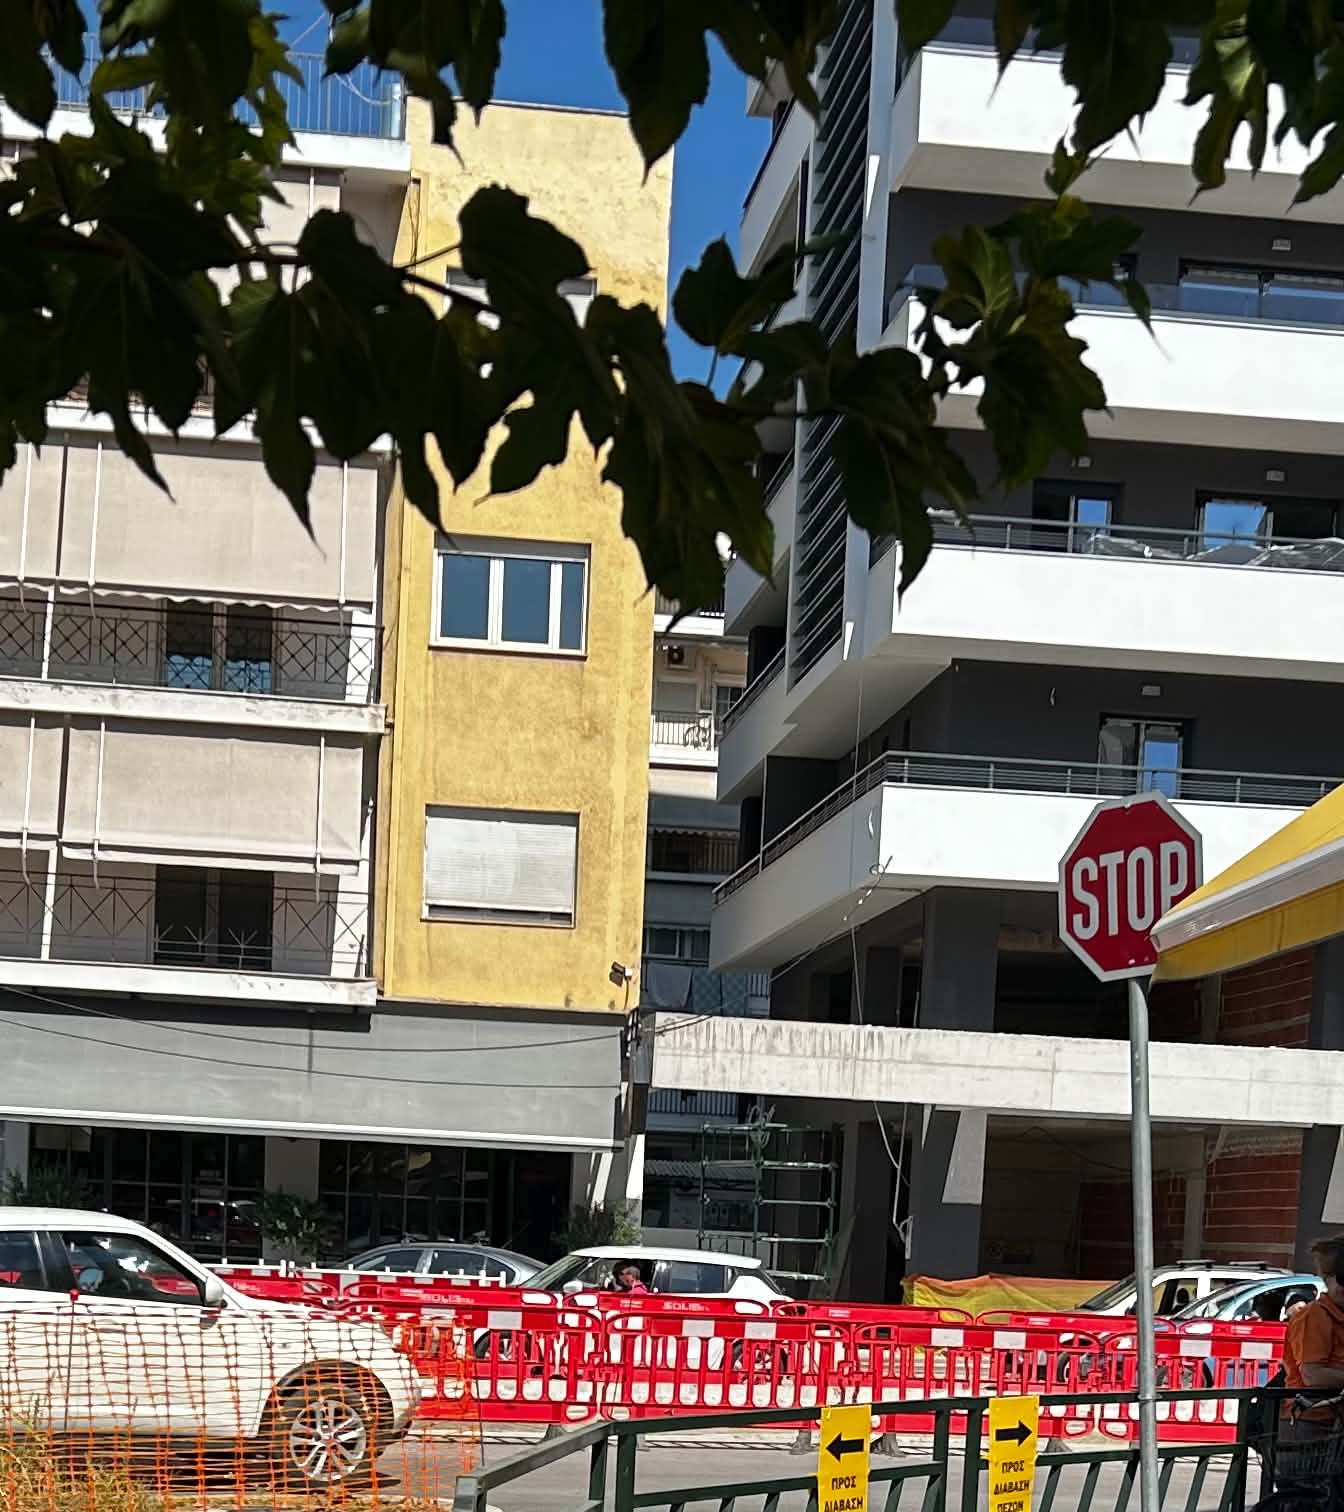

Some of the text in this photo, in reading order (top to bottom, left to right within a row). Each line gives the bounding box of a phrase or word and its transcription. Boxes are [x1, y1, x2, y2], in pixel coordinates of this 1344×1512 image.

[1071, 840, 1188, 940] STOP
[1001, 1460, 1025, 1474] ΠΡΟΣ
[831, 1475, 857, 1490] ΠΡΟΣ
[993, 1480, 1030, 1496] ΔΙΑΒΑΣΗ
